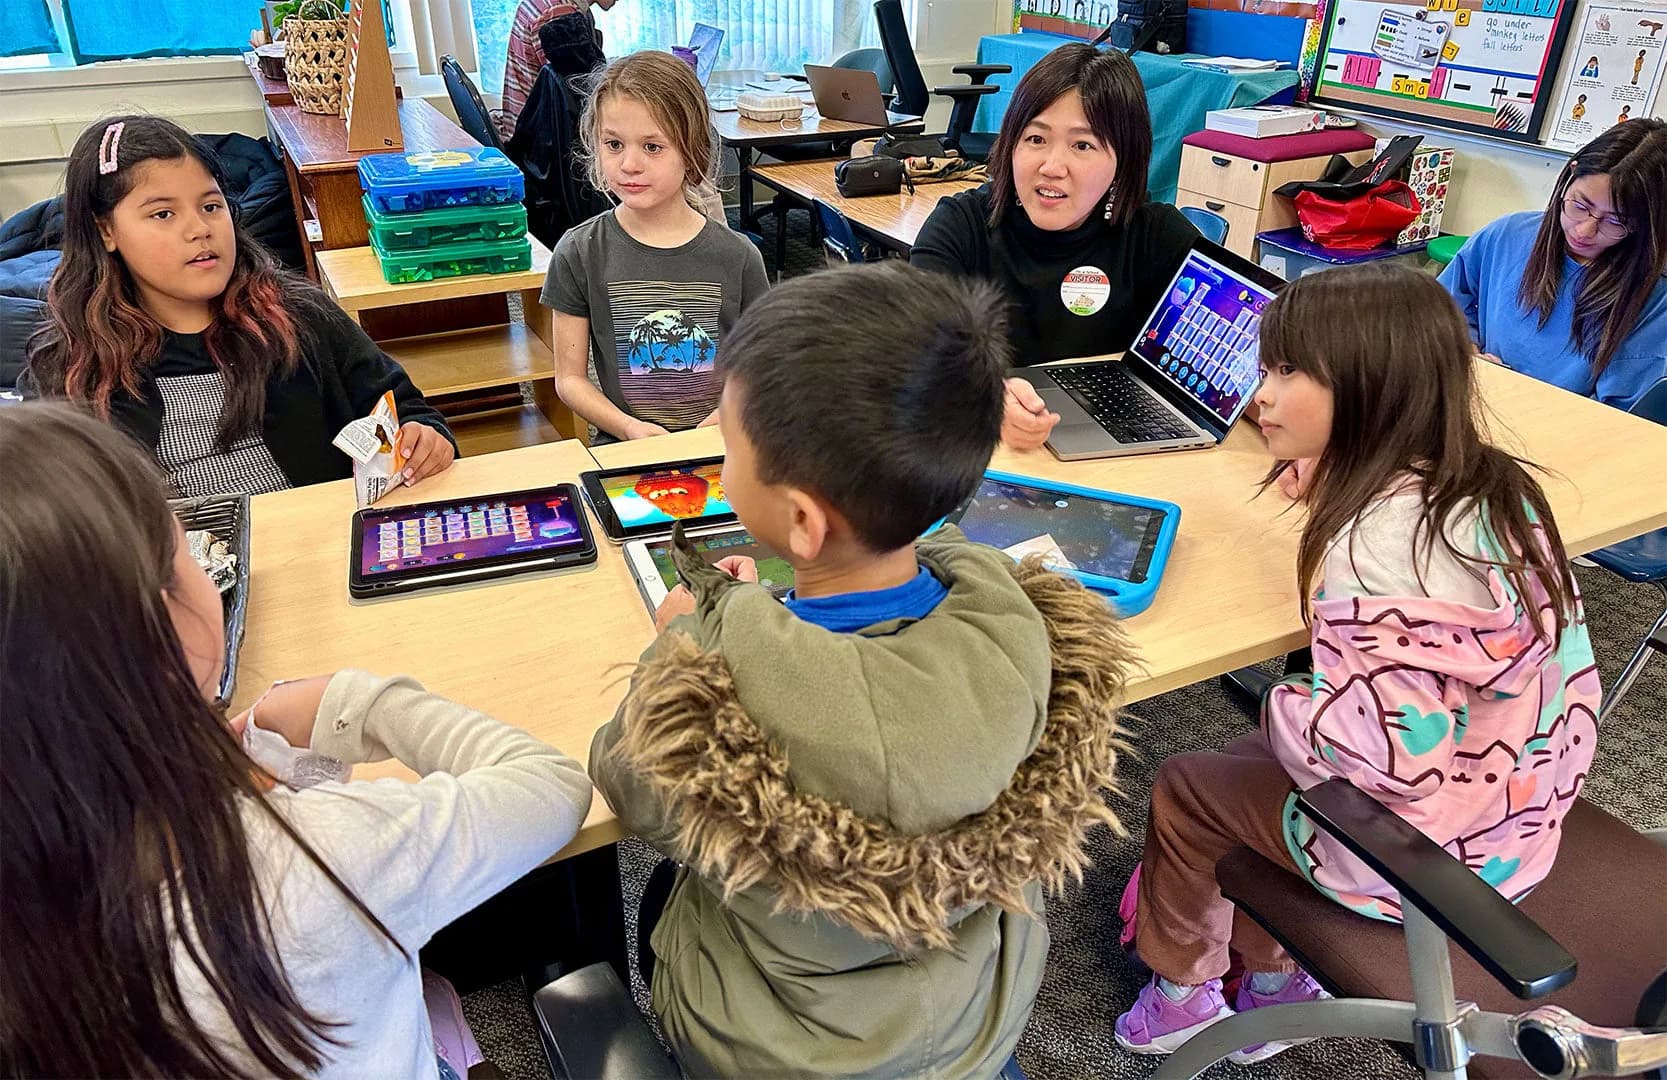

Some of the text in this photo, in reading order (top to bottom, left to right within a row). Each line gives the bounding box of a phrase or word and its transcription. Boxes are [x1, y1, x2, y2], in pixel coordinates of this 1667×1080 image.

[1486, 17, 1532, 33] go under
[1070, 275, 1102, 284] VISITOR
